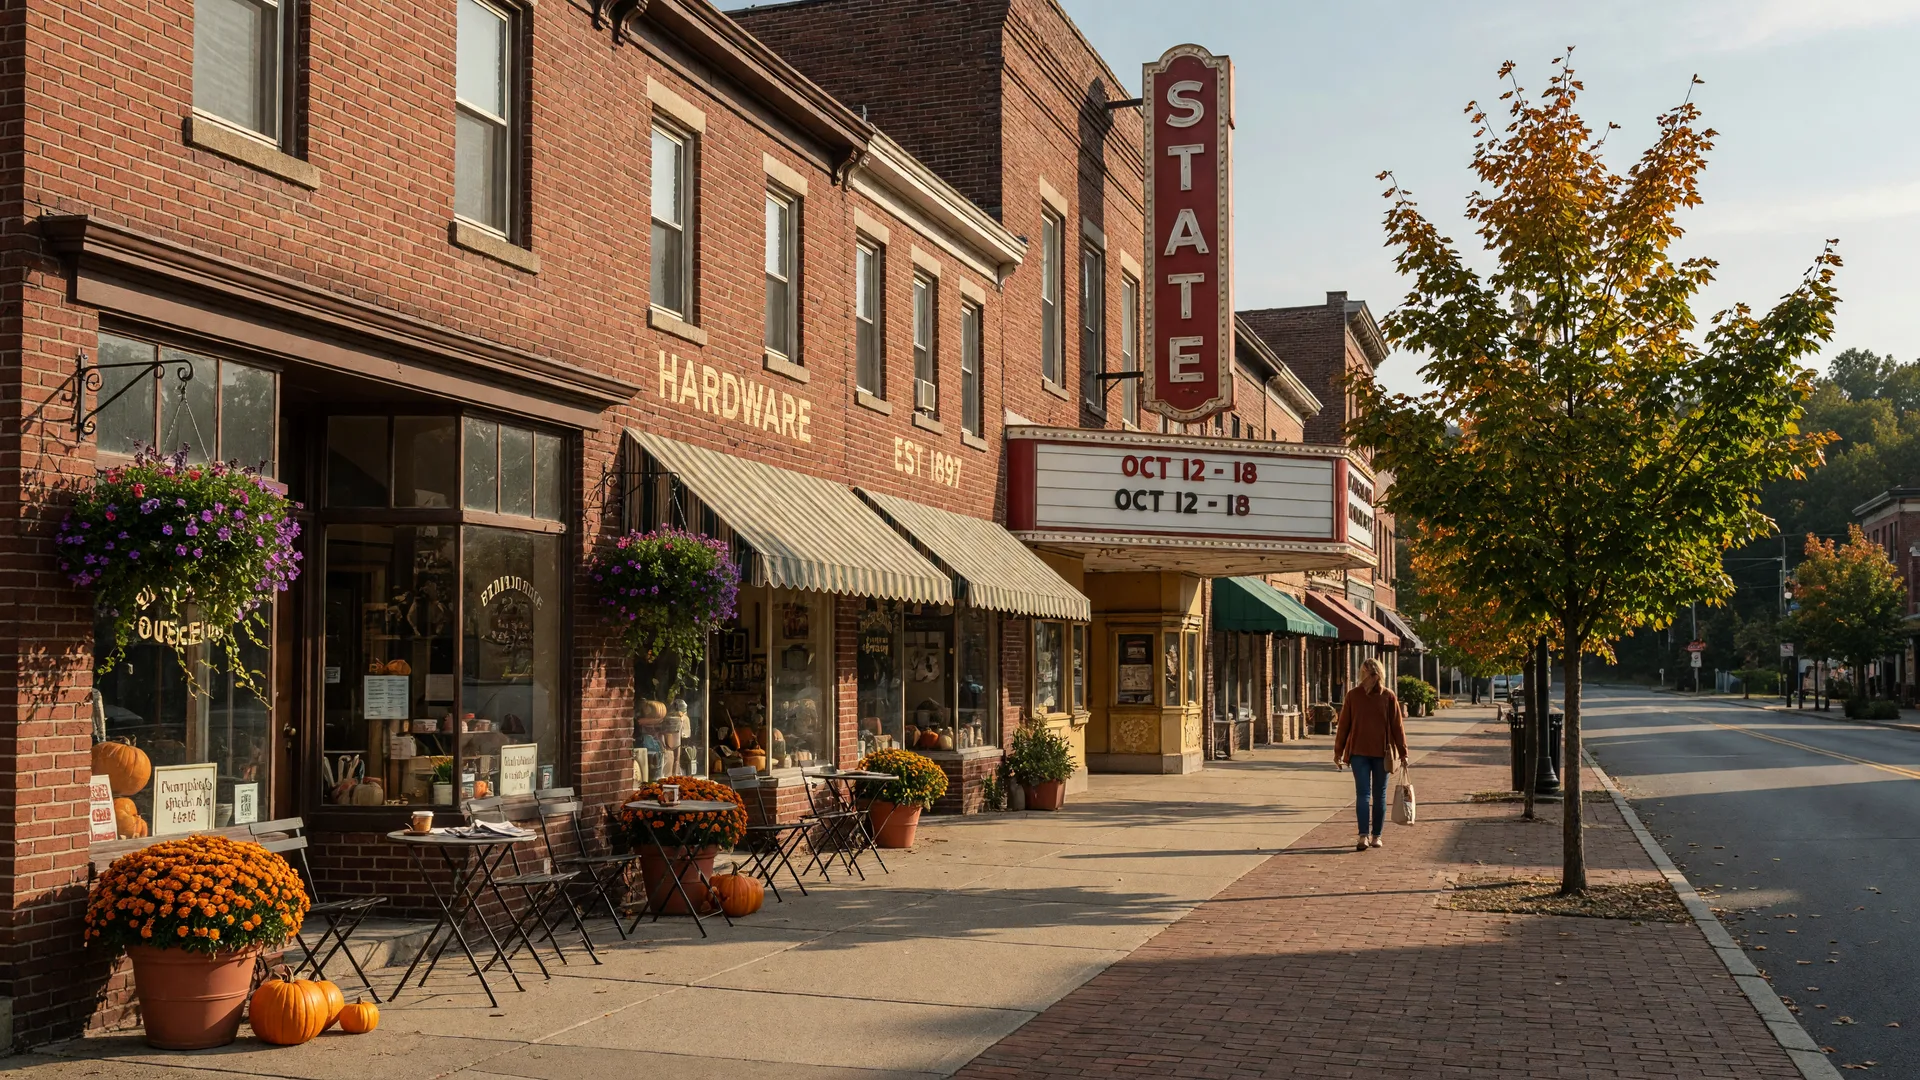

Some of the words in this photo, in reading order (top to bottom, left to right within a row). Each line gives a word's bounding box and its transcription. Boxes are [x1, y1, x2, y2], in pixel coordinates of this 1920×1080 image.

[1163, 80, 1210, 383] STATE
[659, 350, 812, 443] HARDWARE
[895, 436, 923, 477] EST
[930, 449, 962, 488] 1897
[1121, 455, 1171, 480] OCT
[1183, 458, 1205, 482] 12
[1234, 461, 1257, 484] 18
[1115, 488, 1164, 513] OCT
[1176, 491, 1198, 514] 12
[1227, 494, 1250, 517] 18
